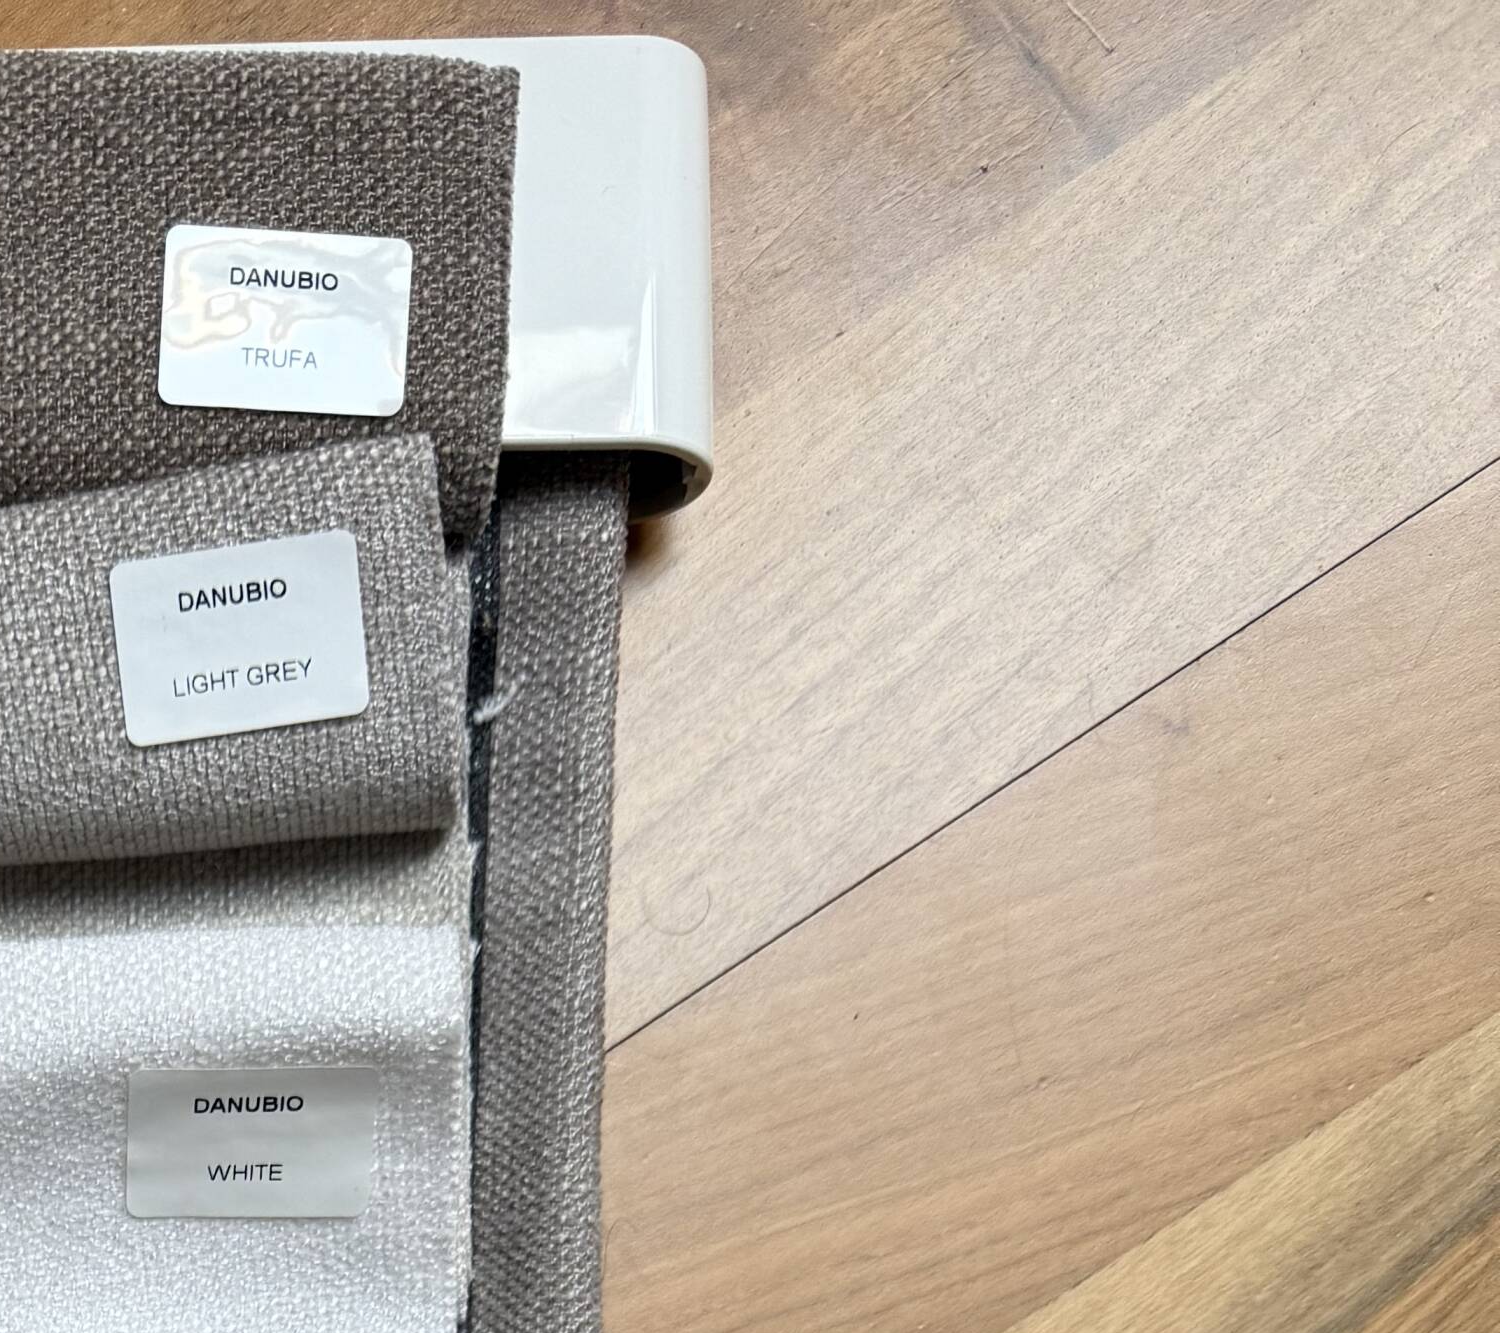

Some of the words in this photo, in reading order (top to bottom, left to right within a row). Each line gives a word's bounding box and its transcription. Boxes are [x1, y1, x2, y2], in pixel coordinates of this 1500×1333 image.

[229, 267, 339, 291] DANUBIO
[241, 347, 318, 369] TRUFA
[178, 578, 288, 613] DANUBIO
[173, 669, 240, 698] LIGHT
[246, 657, 313, 687] GREY
[193, 1095, 305, 1114] DANUBIO
[207, 1163, 285, 1182] WHITE
